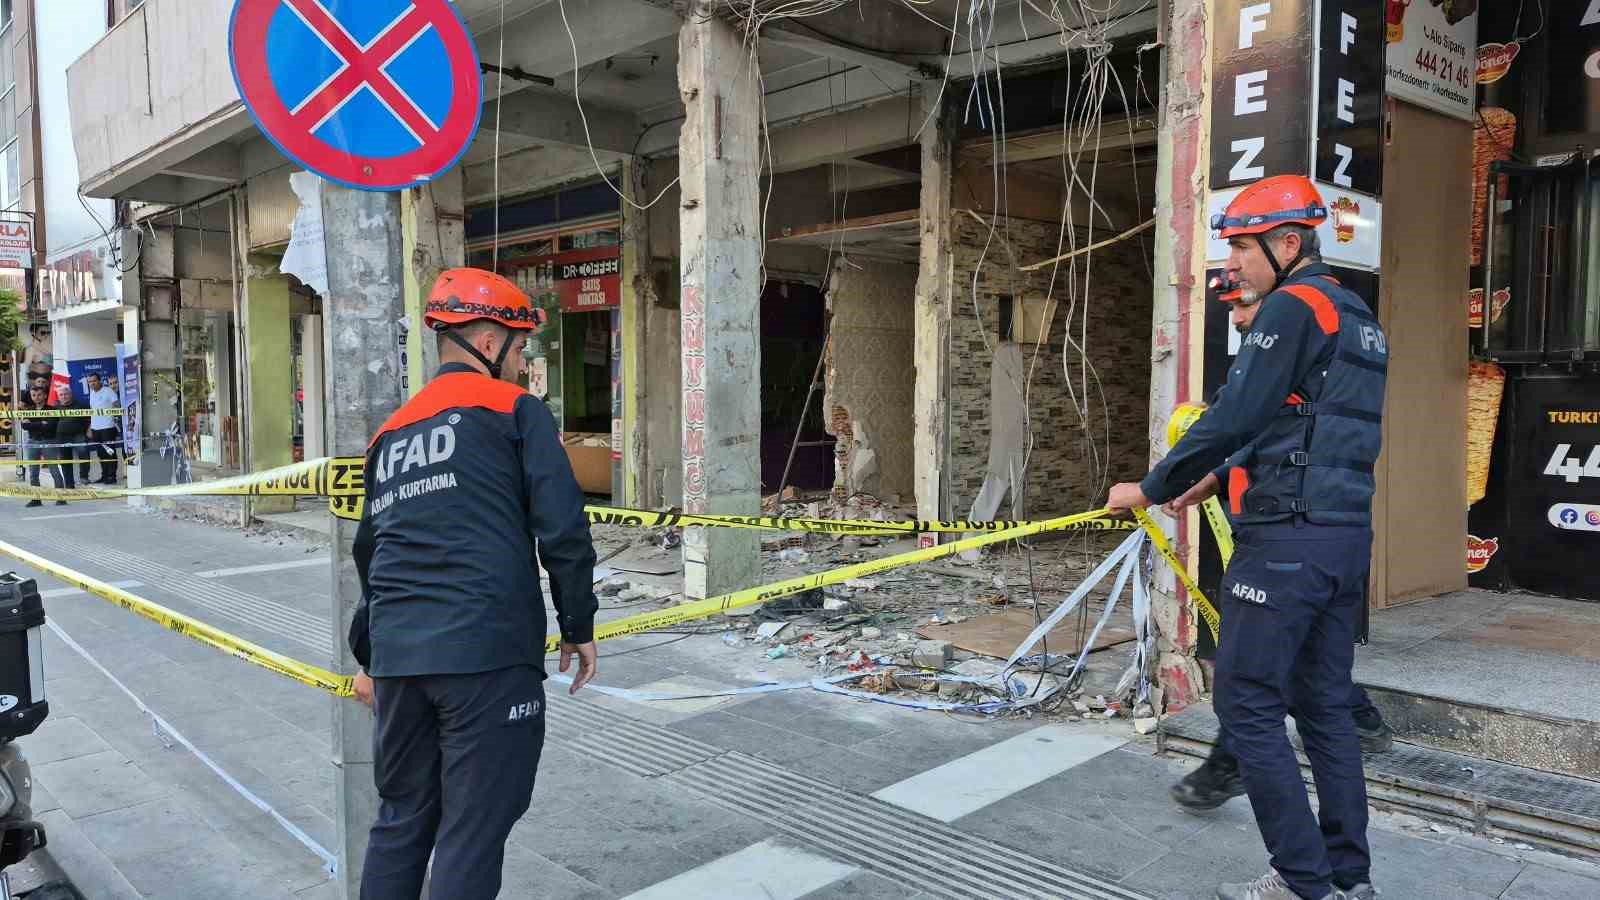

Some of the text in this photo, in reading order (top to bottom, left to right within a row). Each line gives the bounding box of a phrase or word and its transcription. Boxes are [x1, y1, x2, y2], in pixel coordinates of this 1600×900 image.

[1415, 47, 1469, 88] 444 21 46
[399, 473, 458, 500] KURTARMA
[1231, 583, 1267, 604] AFAD
[508, 700, 540, 721] AFAD
